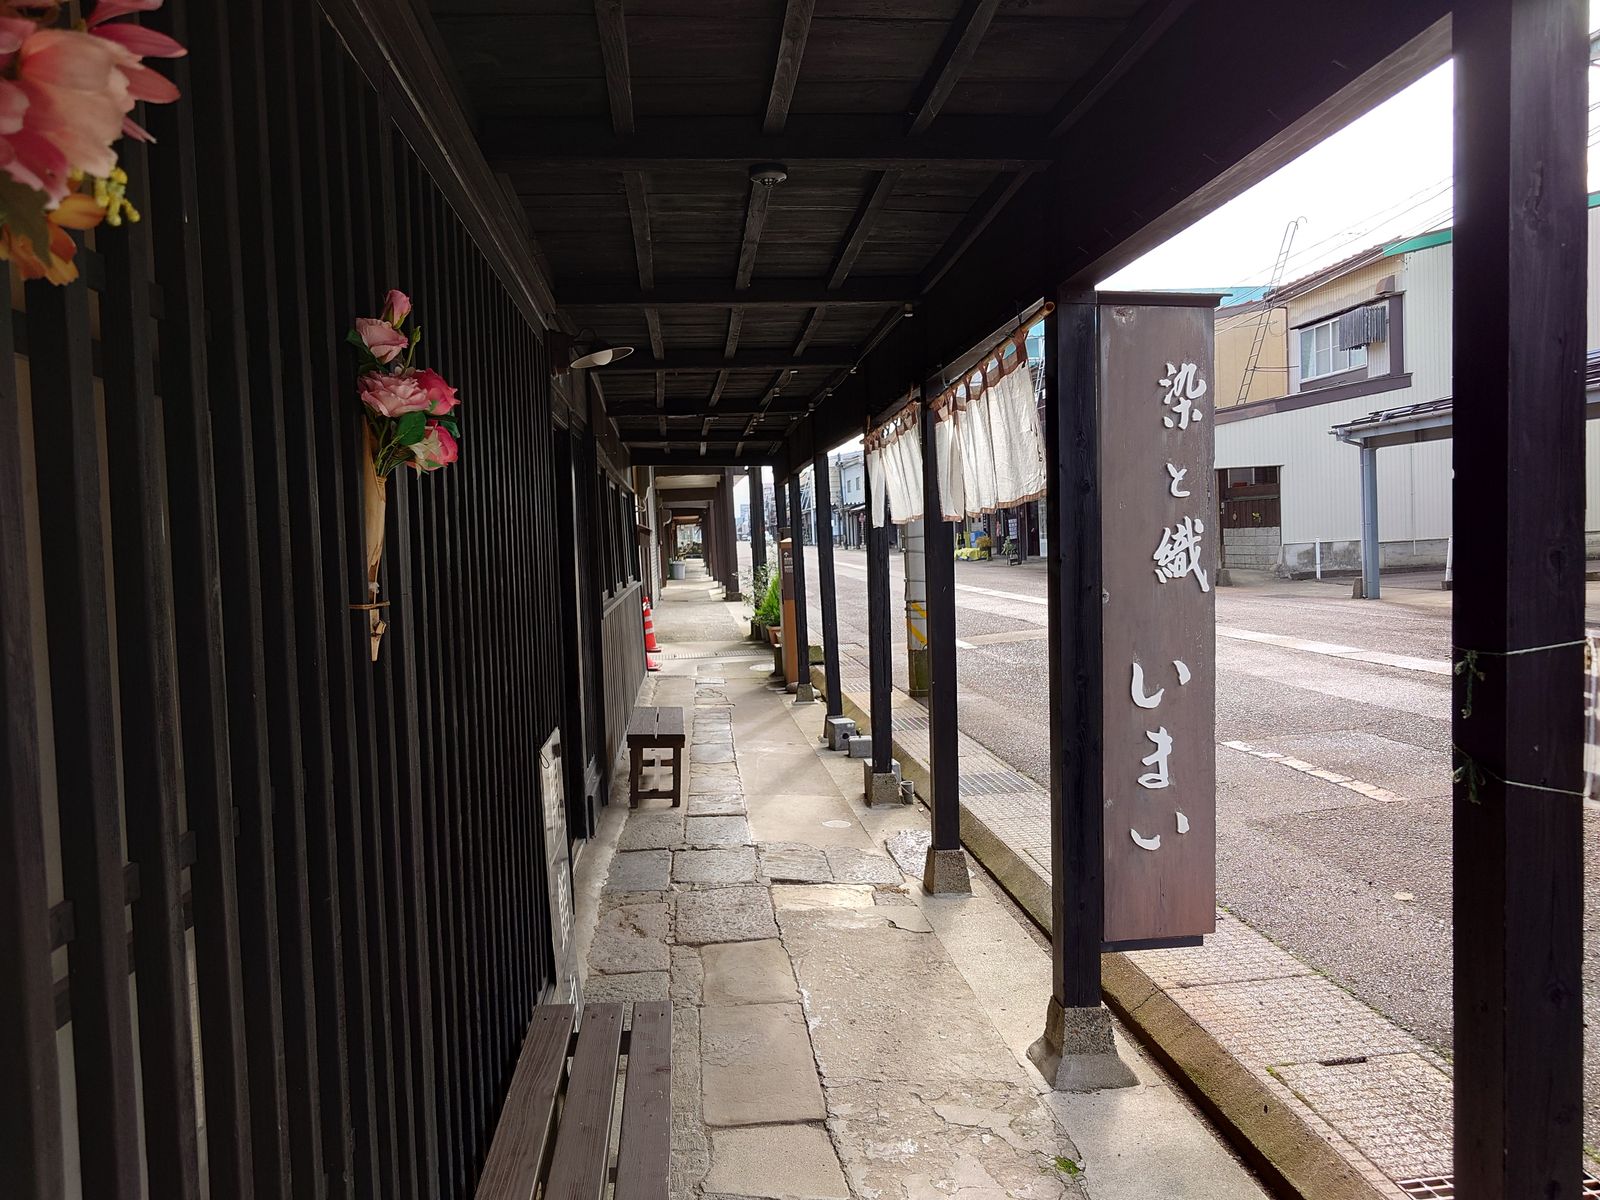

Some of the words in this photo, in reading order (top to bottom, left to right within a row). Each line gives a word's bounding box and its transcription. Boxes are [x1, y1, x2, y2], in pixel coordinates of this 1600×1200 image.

[1153, 362, 1210, 593] 染と織
[1130, 659, 1191, 850] いまい
